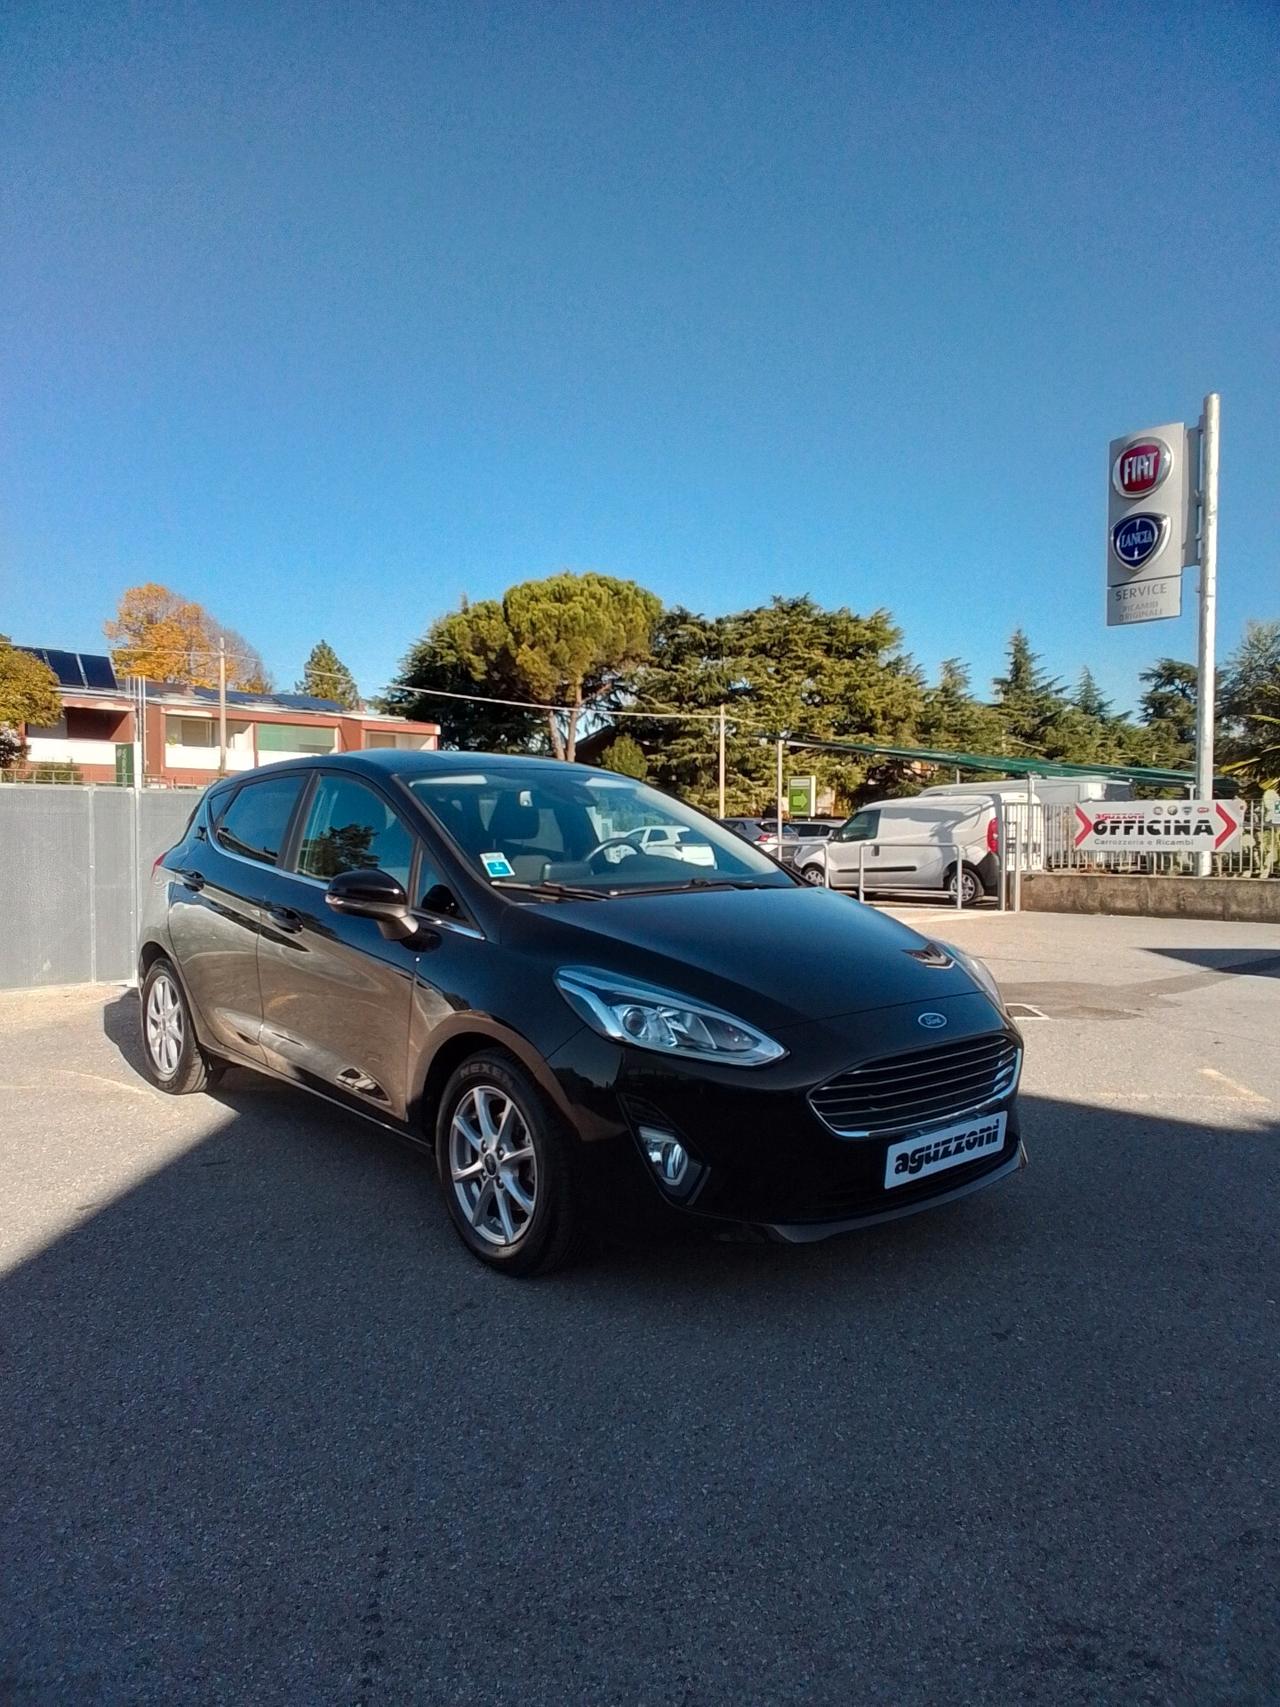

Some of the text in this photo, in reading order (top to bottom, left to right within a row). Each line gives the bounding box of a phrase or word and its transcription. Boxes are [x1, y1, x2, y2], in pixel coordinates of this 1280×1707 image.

[1123, 452, 1158, 486] FIAT
[1120, 529, 1153, 549] LANCIA
[1115, 583, 1167, 602] SERVICE
[1093, 819, 1214, 836] OFFICINA
[1094, 838, 1144, 846] Carrozzeria
[1156, 838, 1194, 846] Ricambi
[894, 1118, 999, 1174] aguzzoni
